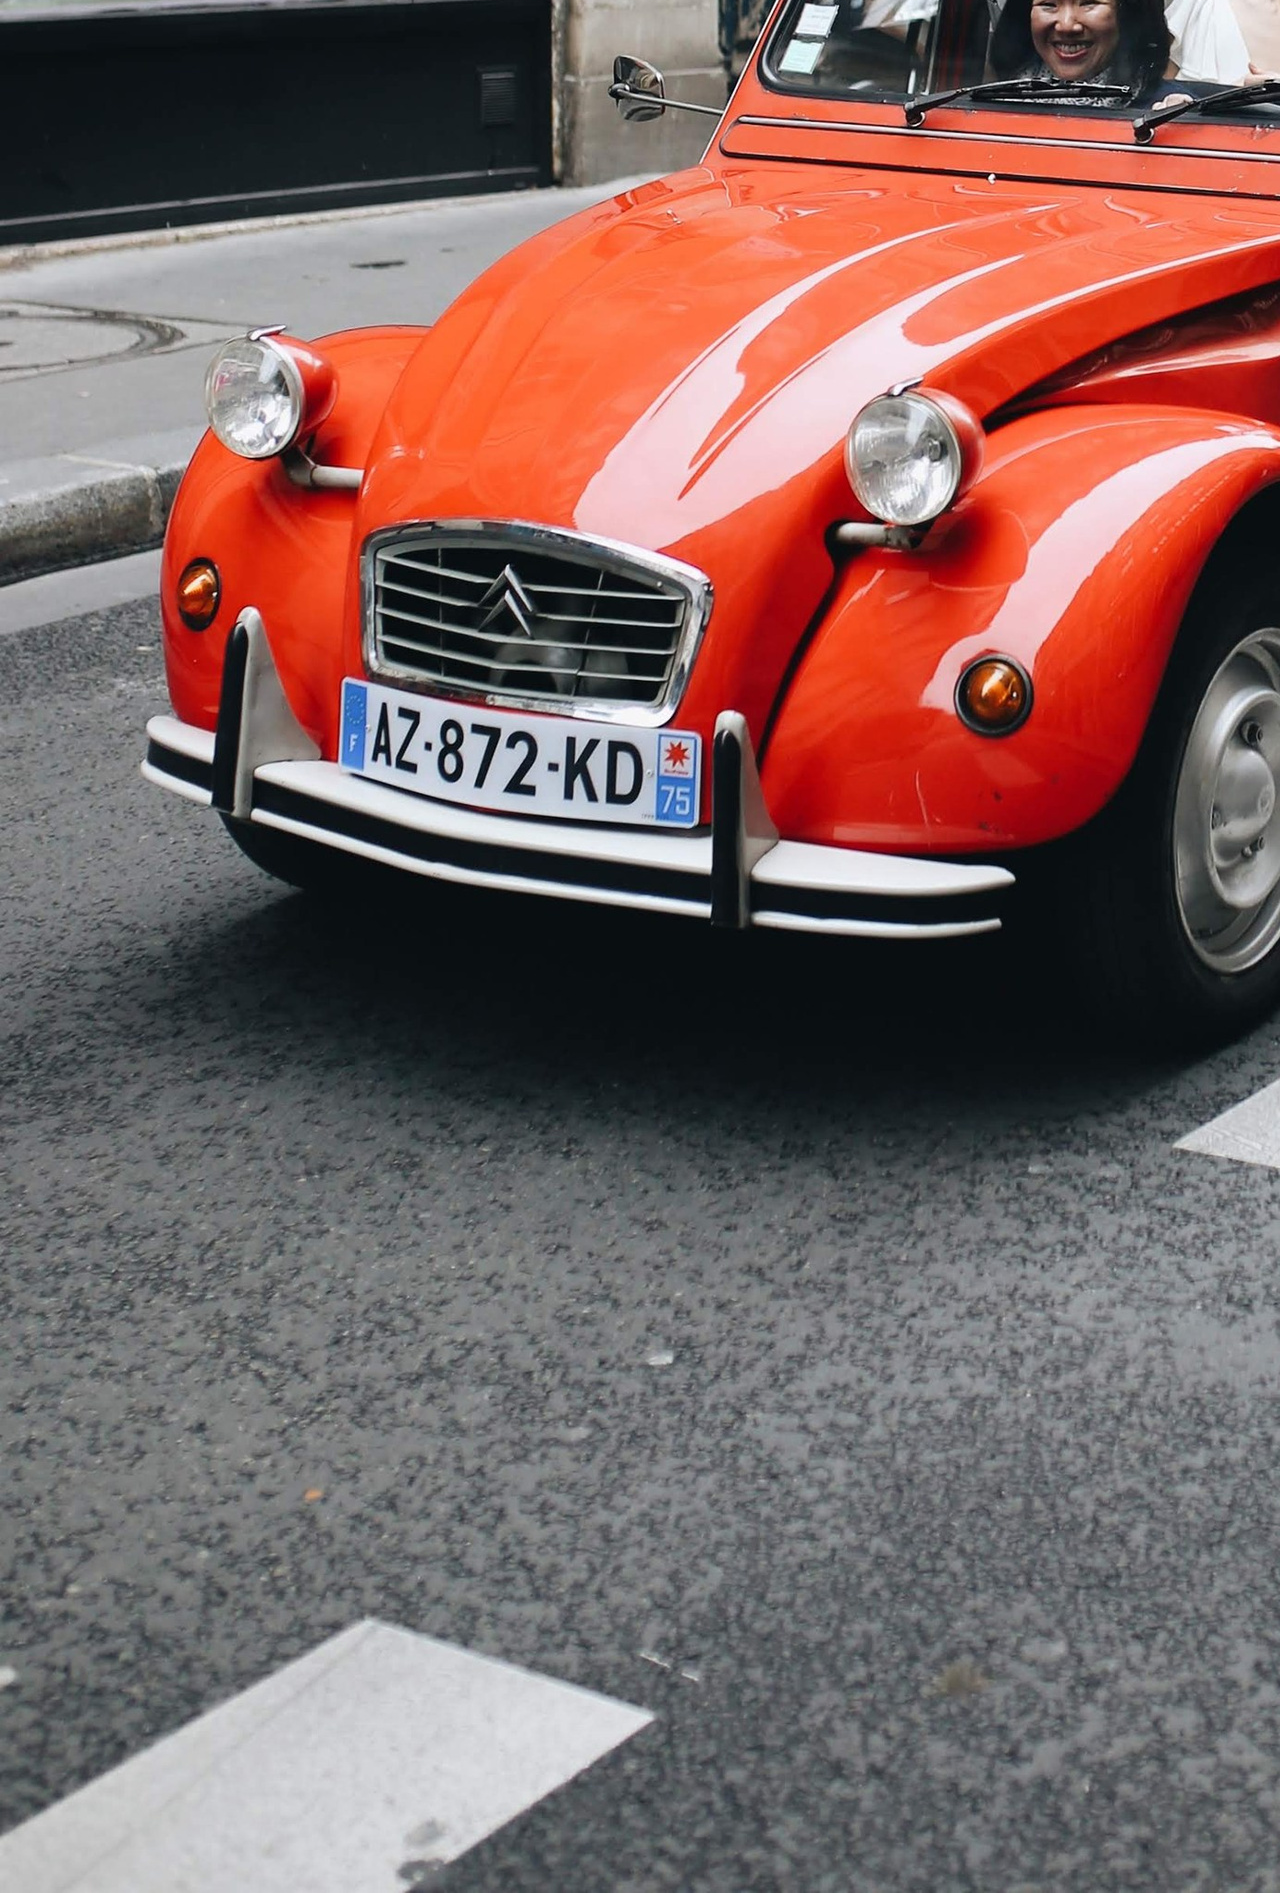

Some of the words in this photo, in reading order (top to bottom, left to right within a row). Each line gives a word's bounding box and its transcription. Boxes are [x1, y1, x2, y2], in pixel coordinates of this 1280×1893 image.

[350, 733, 358, 752] F
[371, 702, 644, 806] AZ-872-KD
[661, 784, 691, 816] 75
